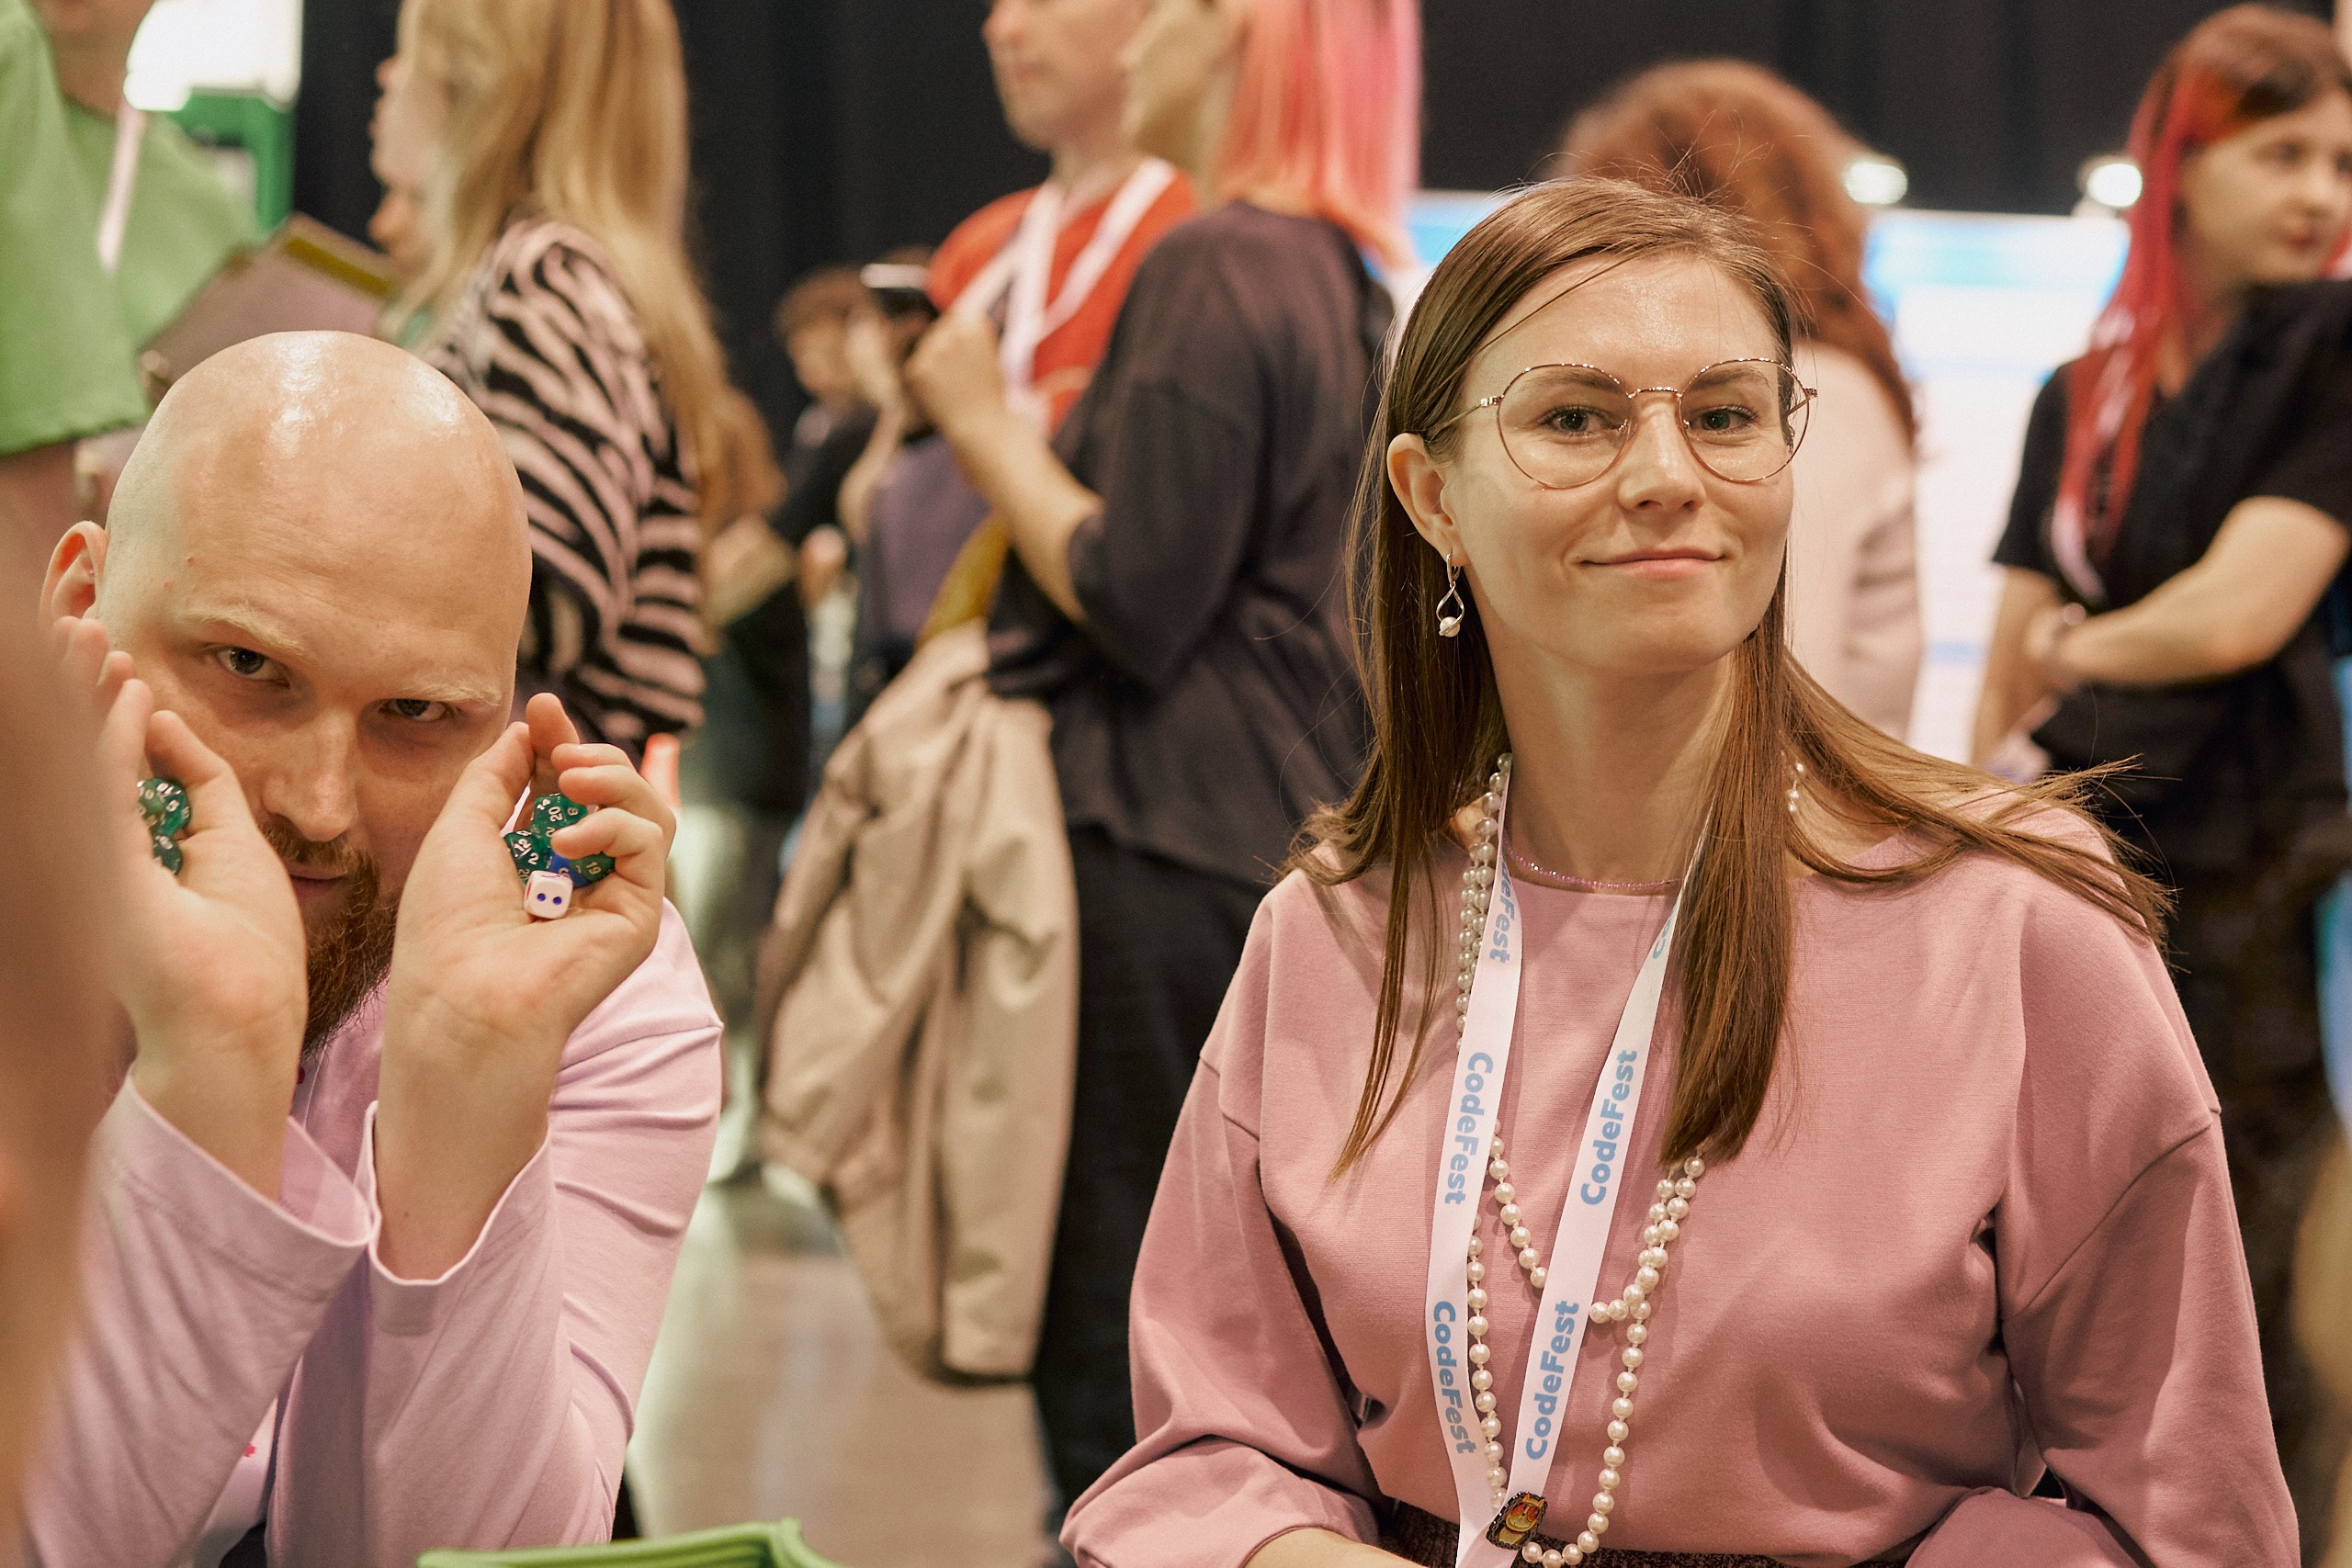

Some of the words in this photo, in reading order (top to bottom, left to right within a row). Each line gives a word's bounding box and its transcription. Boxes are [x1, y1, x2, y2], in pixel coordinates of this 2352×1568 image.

[527, 852, 539, 865] 2
[548, 806, 563, 822] 20
[586, 861, 602, 874] 19
[1444, 1051, 1494, 1205] CodeFest
[1580, 1049, 1638, 1206] CodeFest
[1433, 1301, 1476, 1455] CodeFest
[1525, 1300, 1580, 1461] CodeFest
